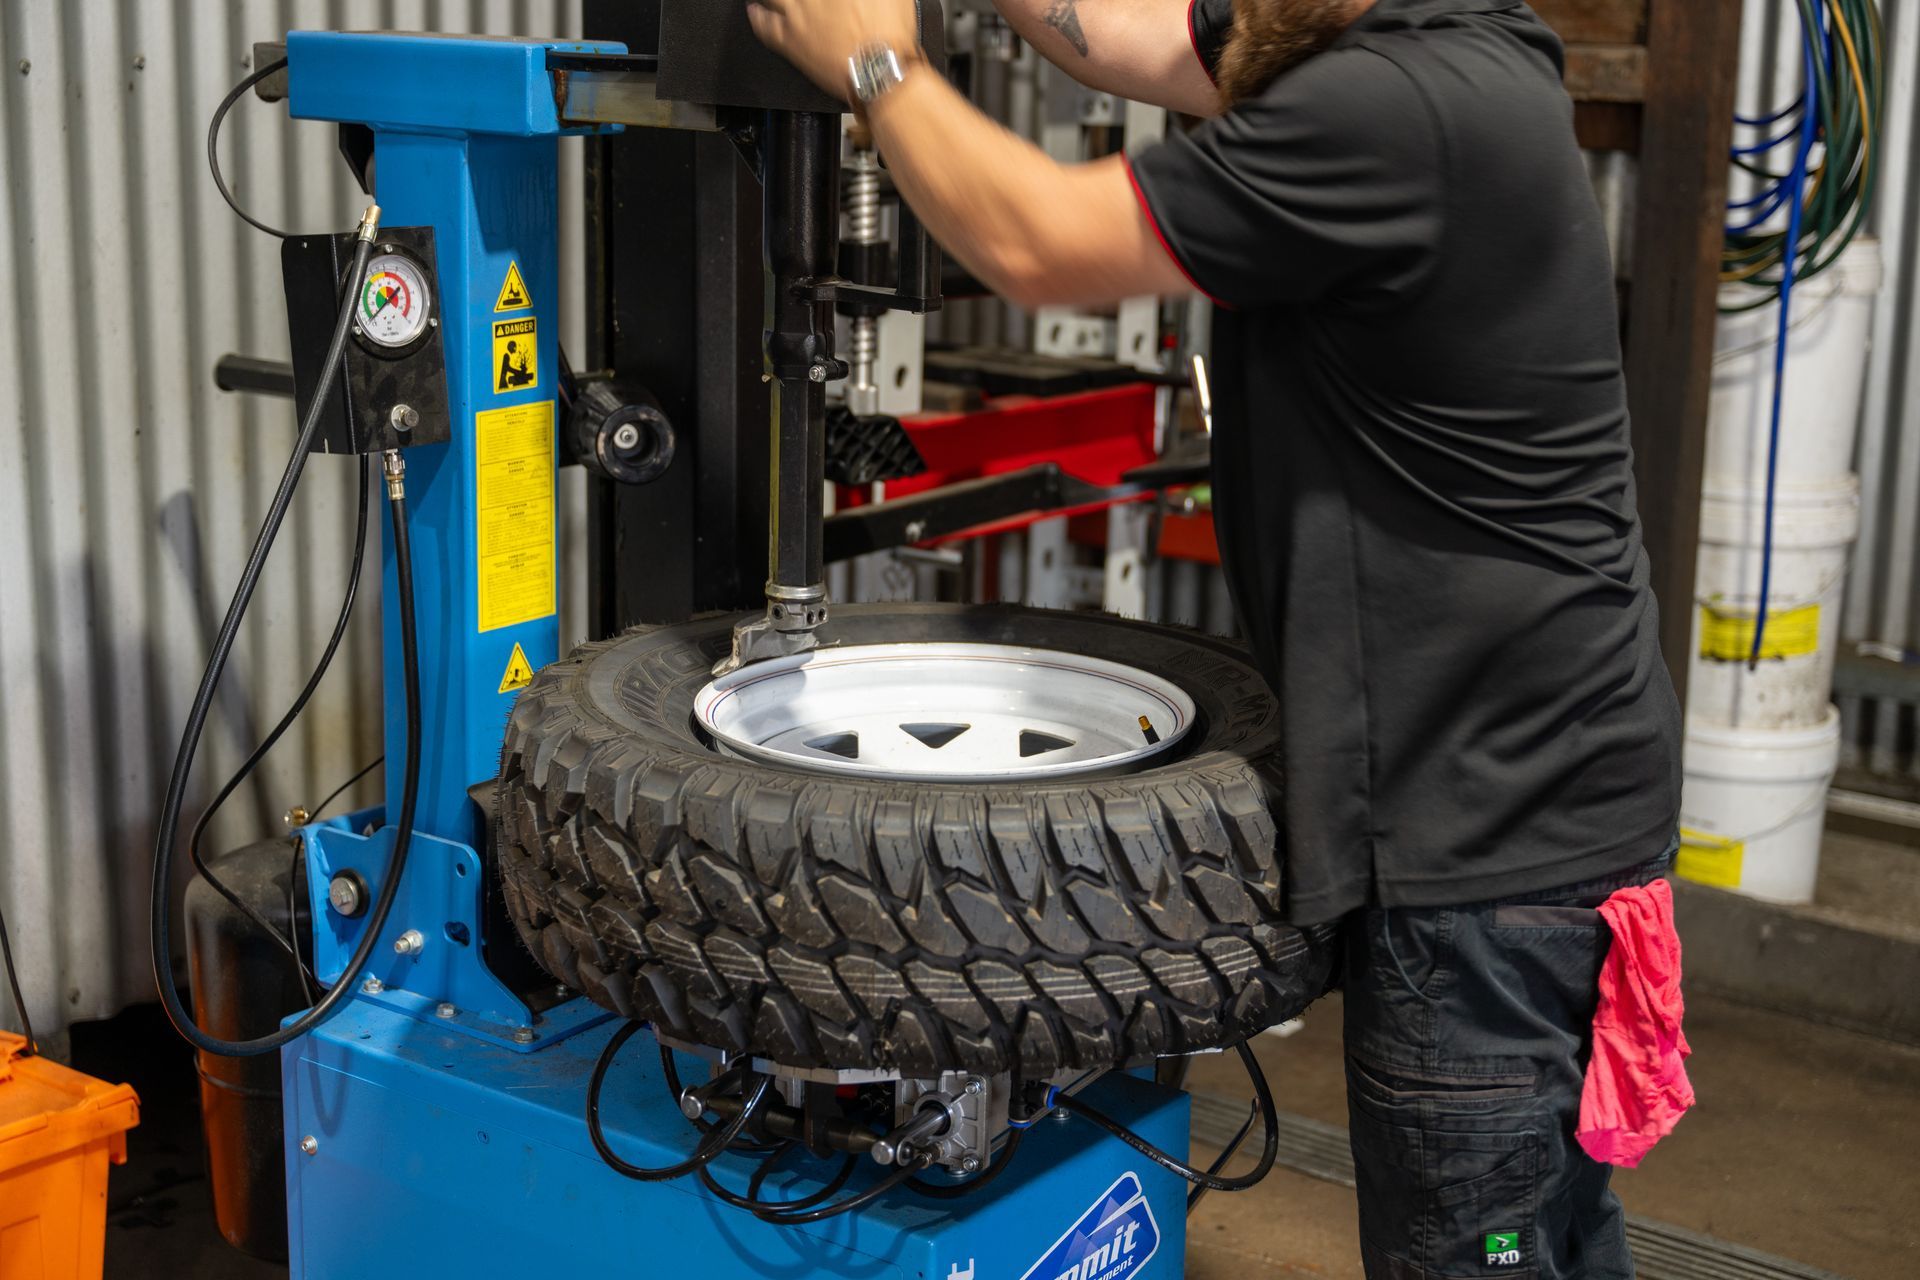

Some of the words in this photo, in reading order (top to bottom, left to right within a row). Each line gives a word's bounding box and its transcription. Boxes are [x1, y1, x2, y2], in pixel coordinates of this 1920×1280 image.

[504, 321, 534, 335] DANGER
[1487, 1250, 1520, 1265] FXD
[1094, 1255, 1134, 1280] ment
